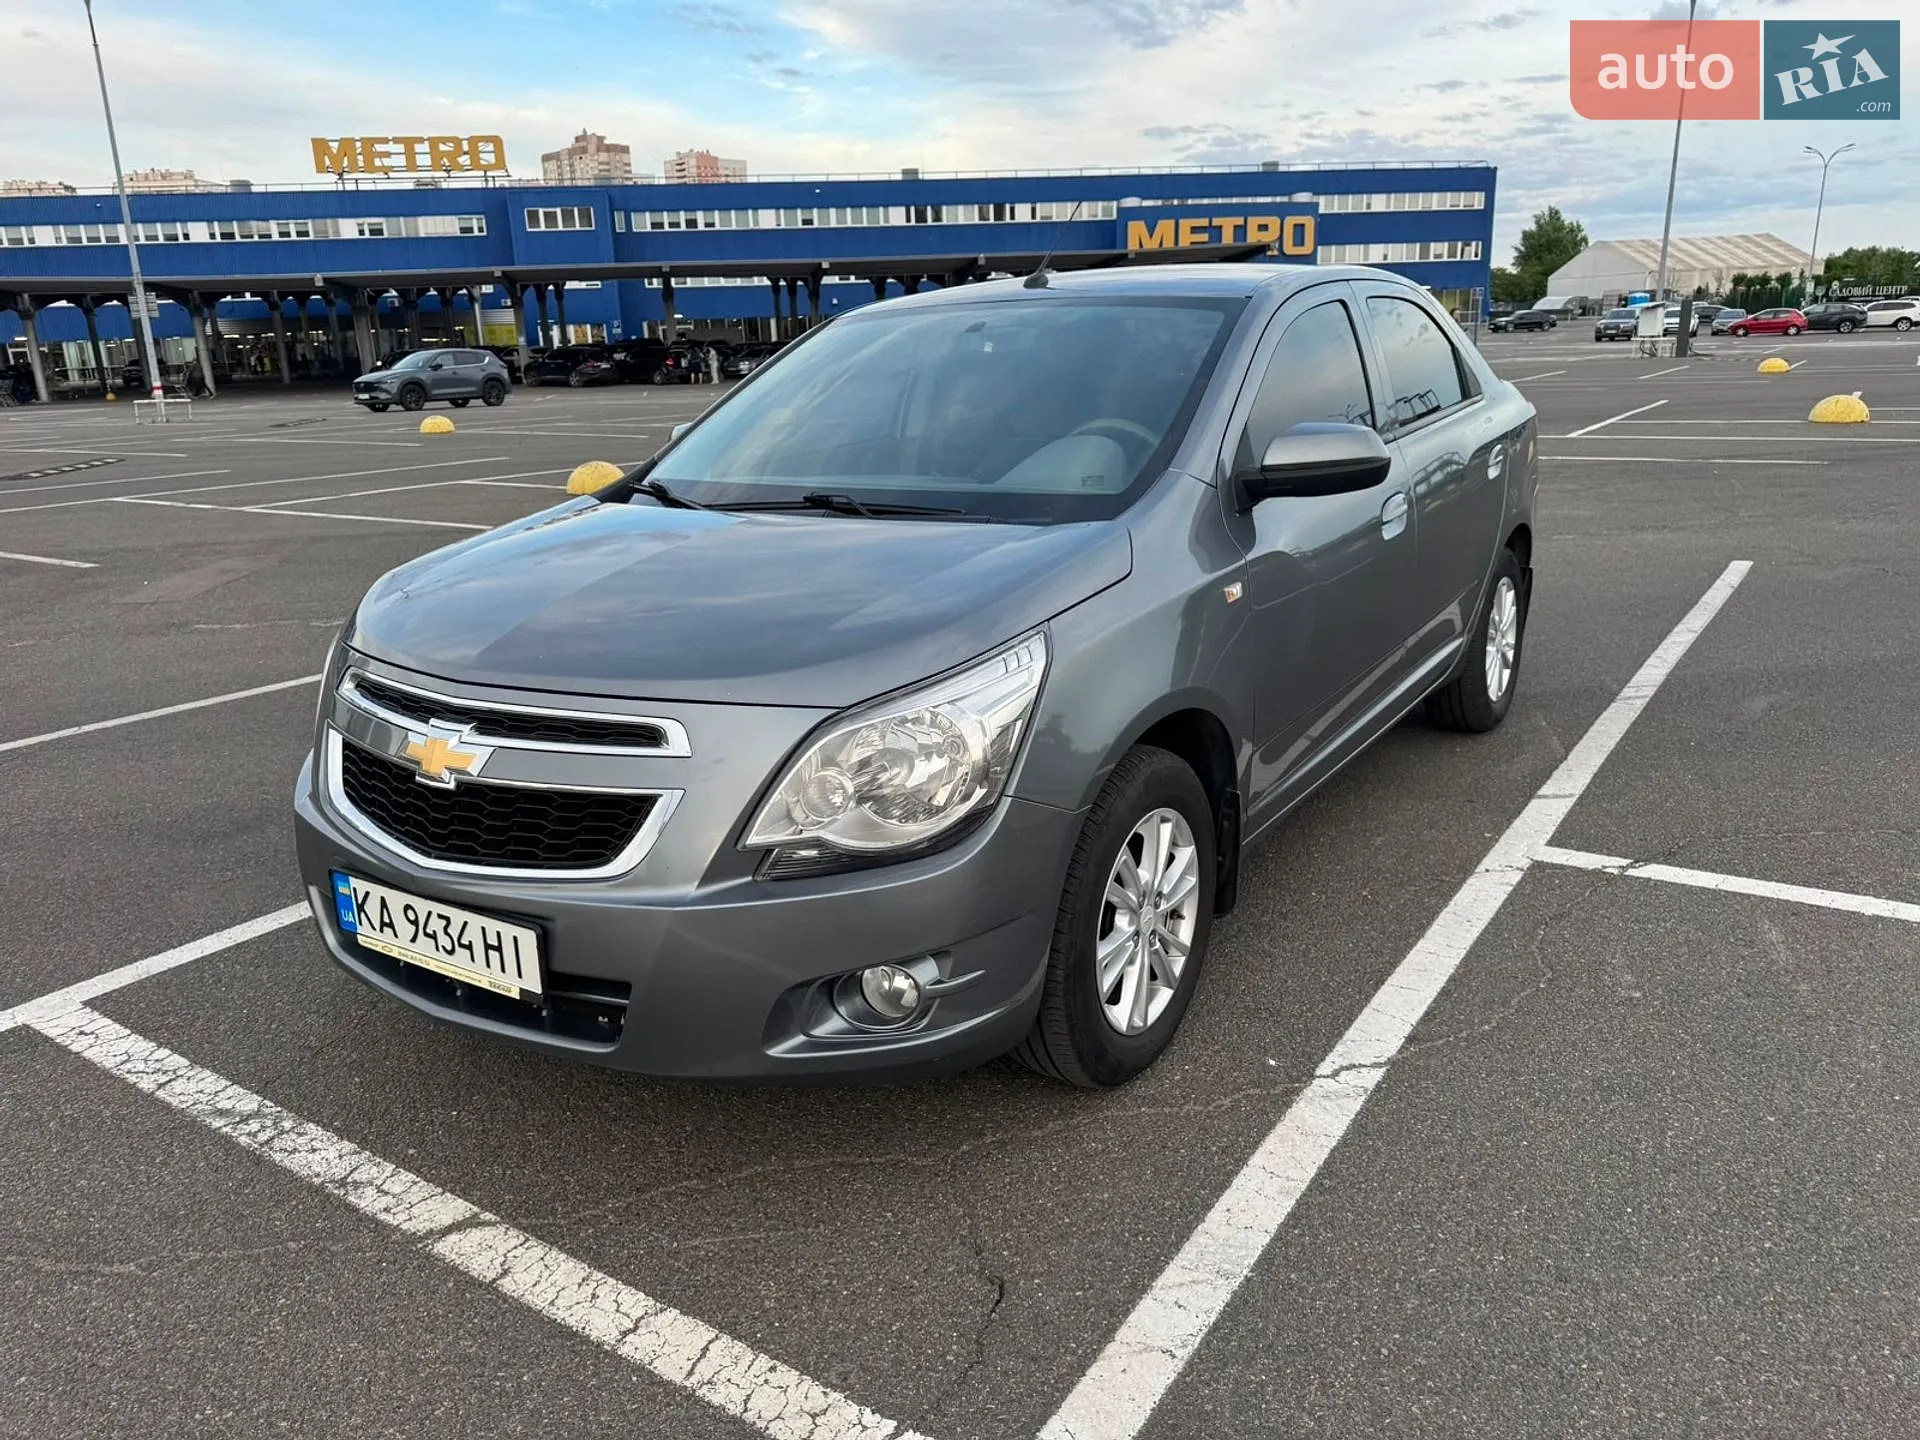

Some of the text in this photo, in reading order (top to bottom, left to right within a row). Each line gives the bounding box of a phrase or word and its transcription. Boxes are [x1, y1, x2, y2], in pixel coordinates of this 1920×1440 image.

[310, 135, 506, 174] METRO
[1127, 215, 1315, 256] METRO
[341, 910, 356, 924] UA
